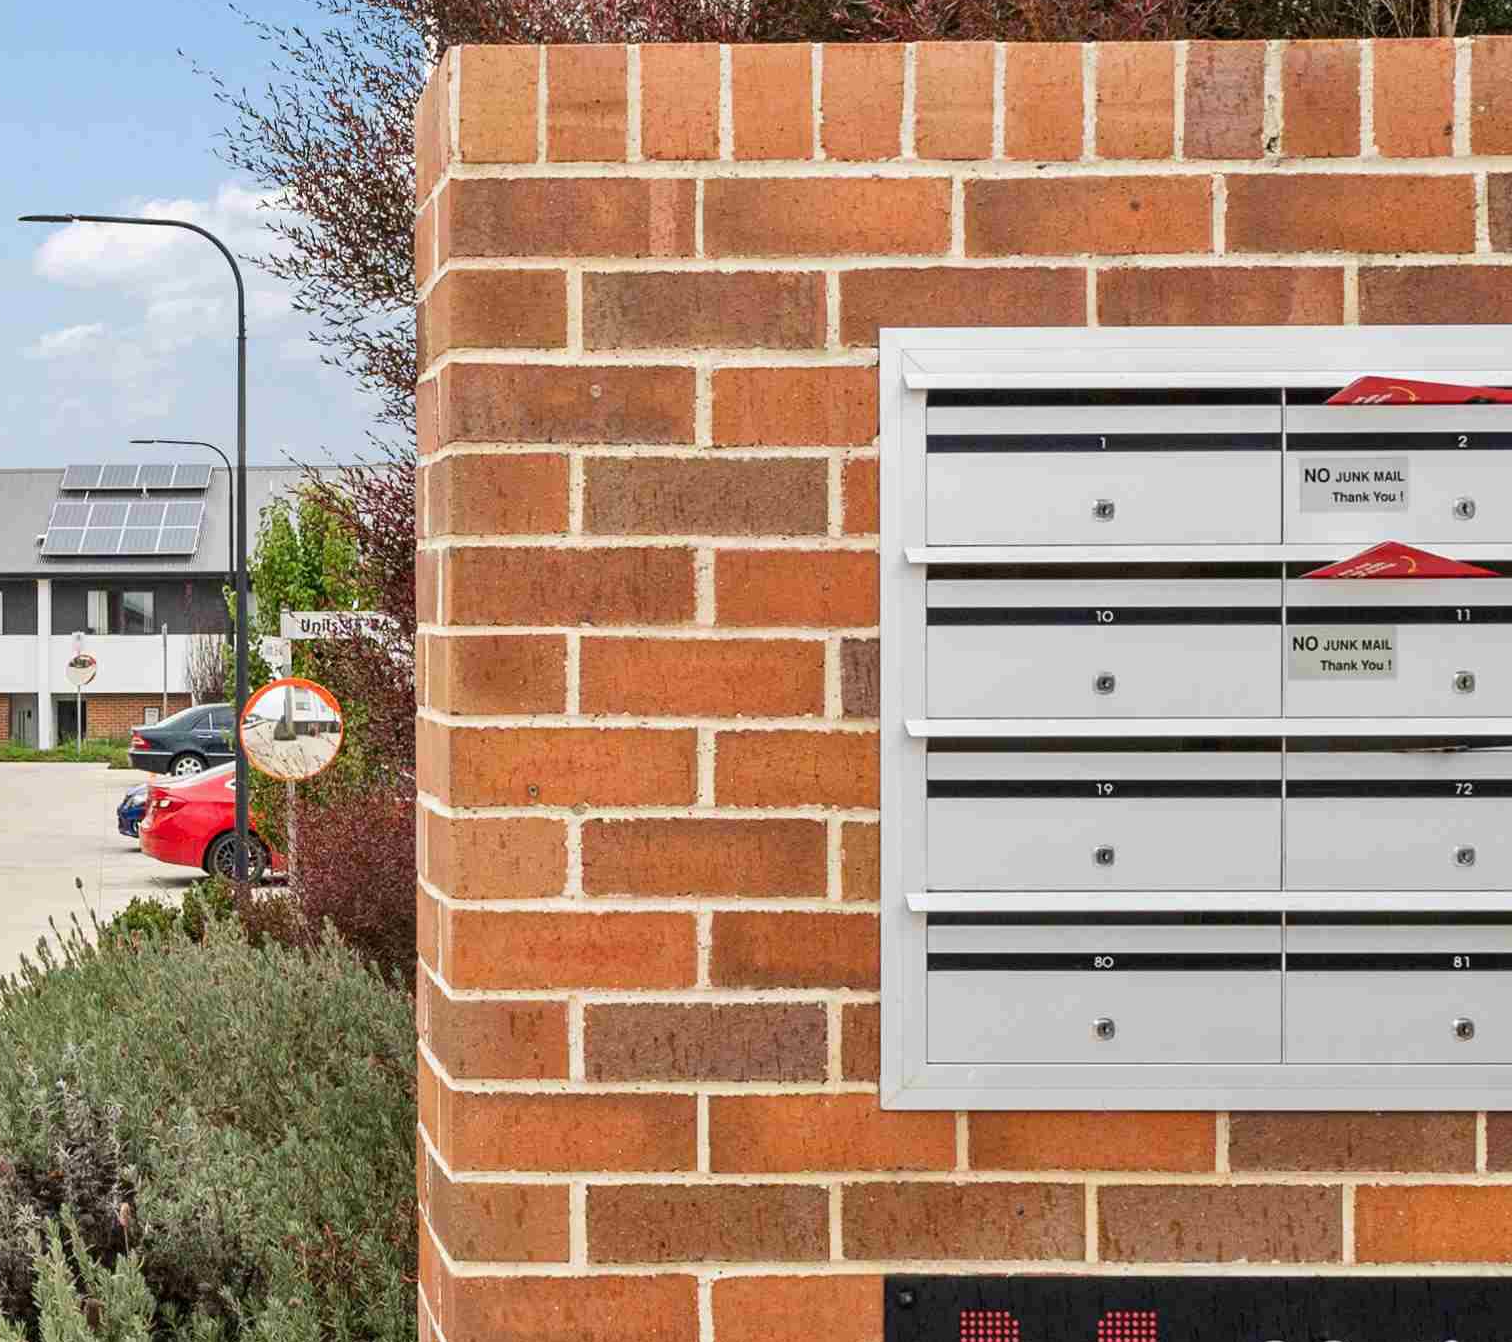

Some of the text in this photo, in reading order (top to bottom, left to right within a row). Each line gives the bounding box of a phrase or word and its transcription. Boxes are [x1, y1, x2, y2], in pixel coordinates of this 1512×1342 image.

[1100, 437, 1106, 448] 1
[1457, 435, 1468, 448] 2
[1304, 467, 1404, 483] NO JUNK MAIL
[1332, 491, 1370, 503] Thank
[1373, 491, 1396, 503] You
[1095, 610, 1114, 623] 10
[1455, 608, 1471, 621] 11
[1292, 635, 1393, 652] NO JUNK MAIL
[1319, 659, 1358, 671] Thank
[1361, 659, 1384, 671] You
[1095, 783, 1114, 796] 19
[1455, 782, 1473, 796] 72
[1093, 955, 1114, 969] 80
[1453, 955, 1470, 968] 81
